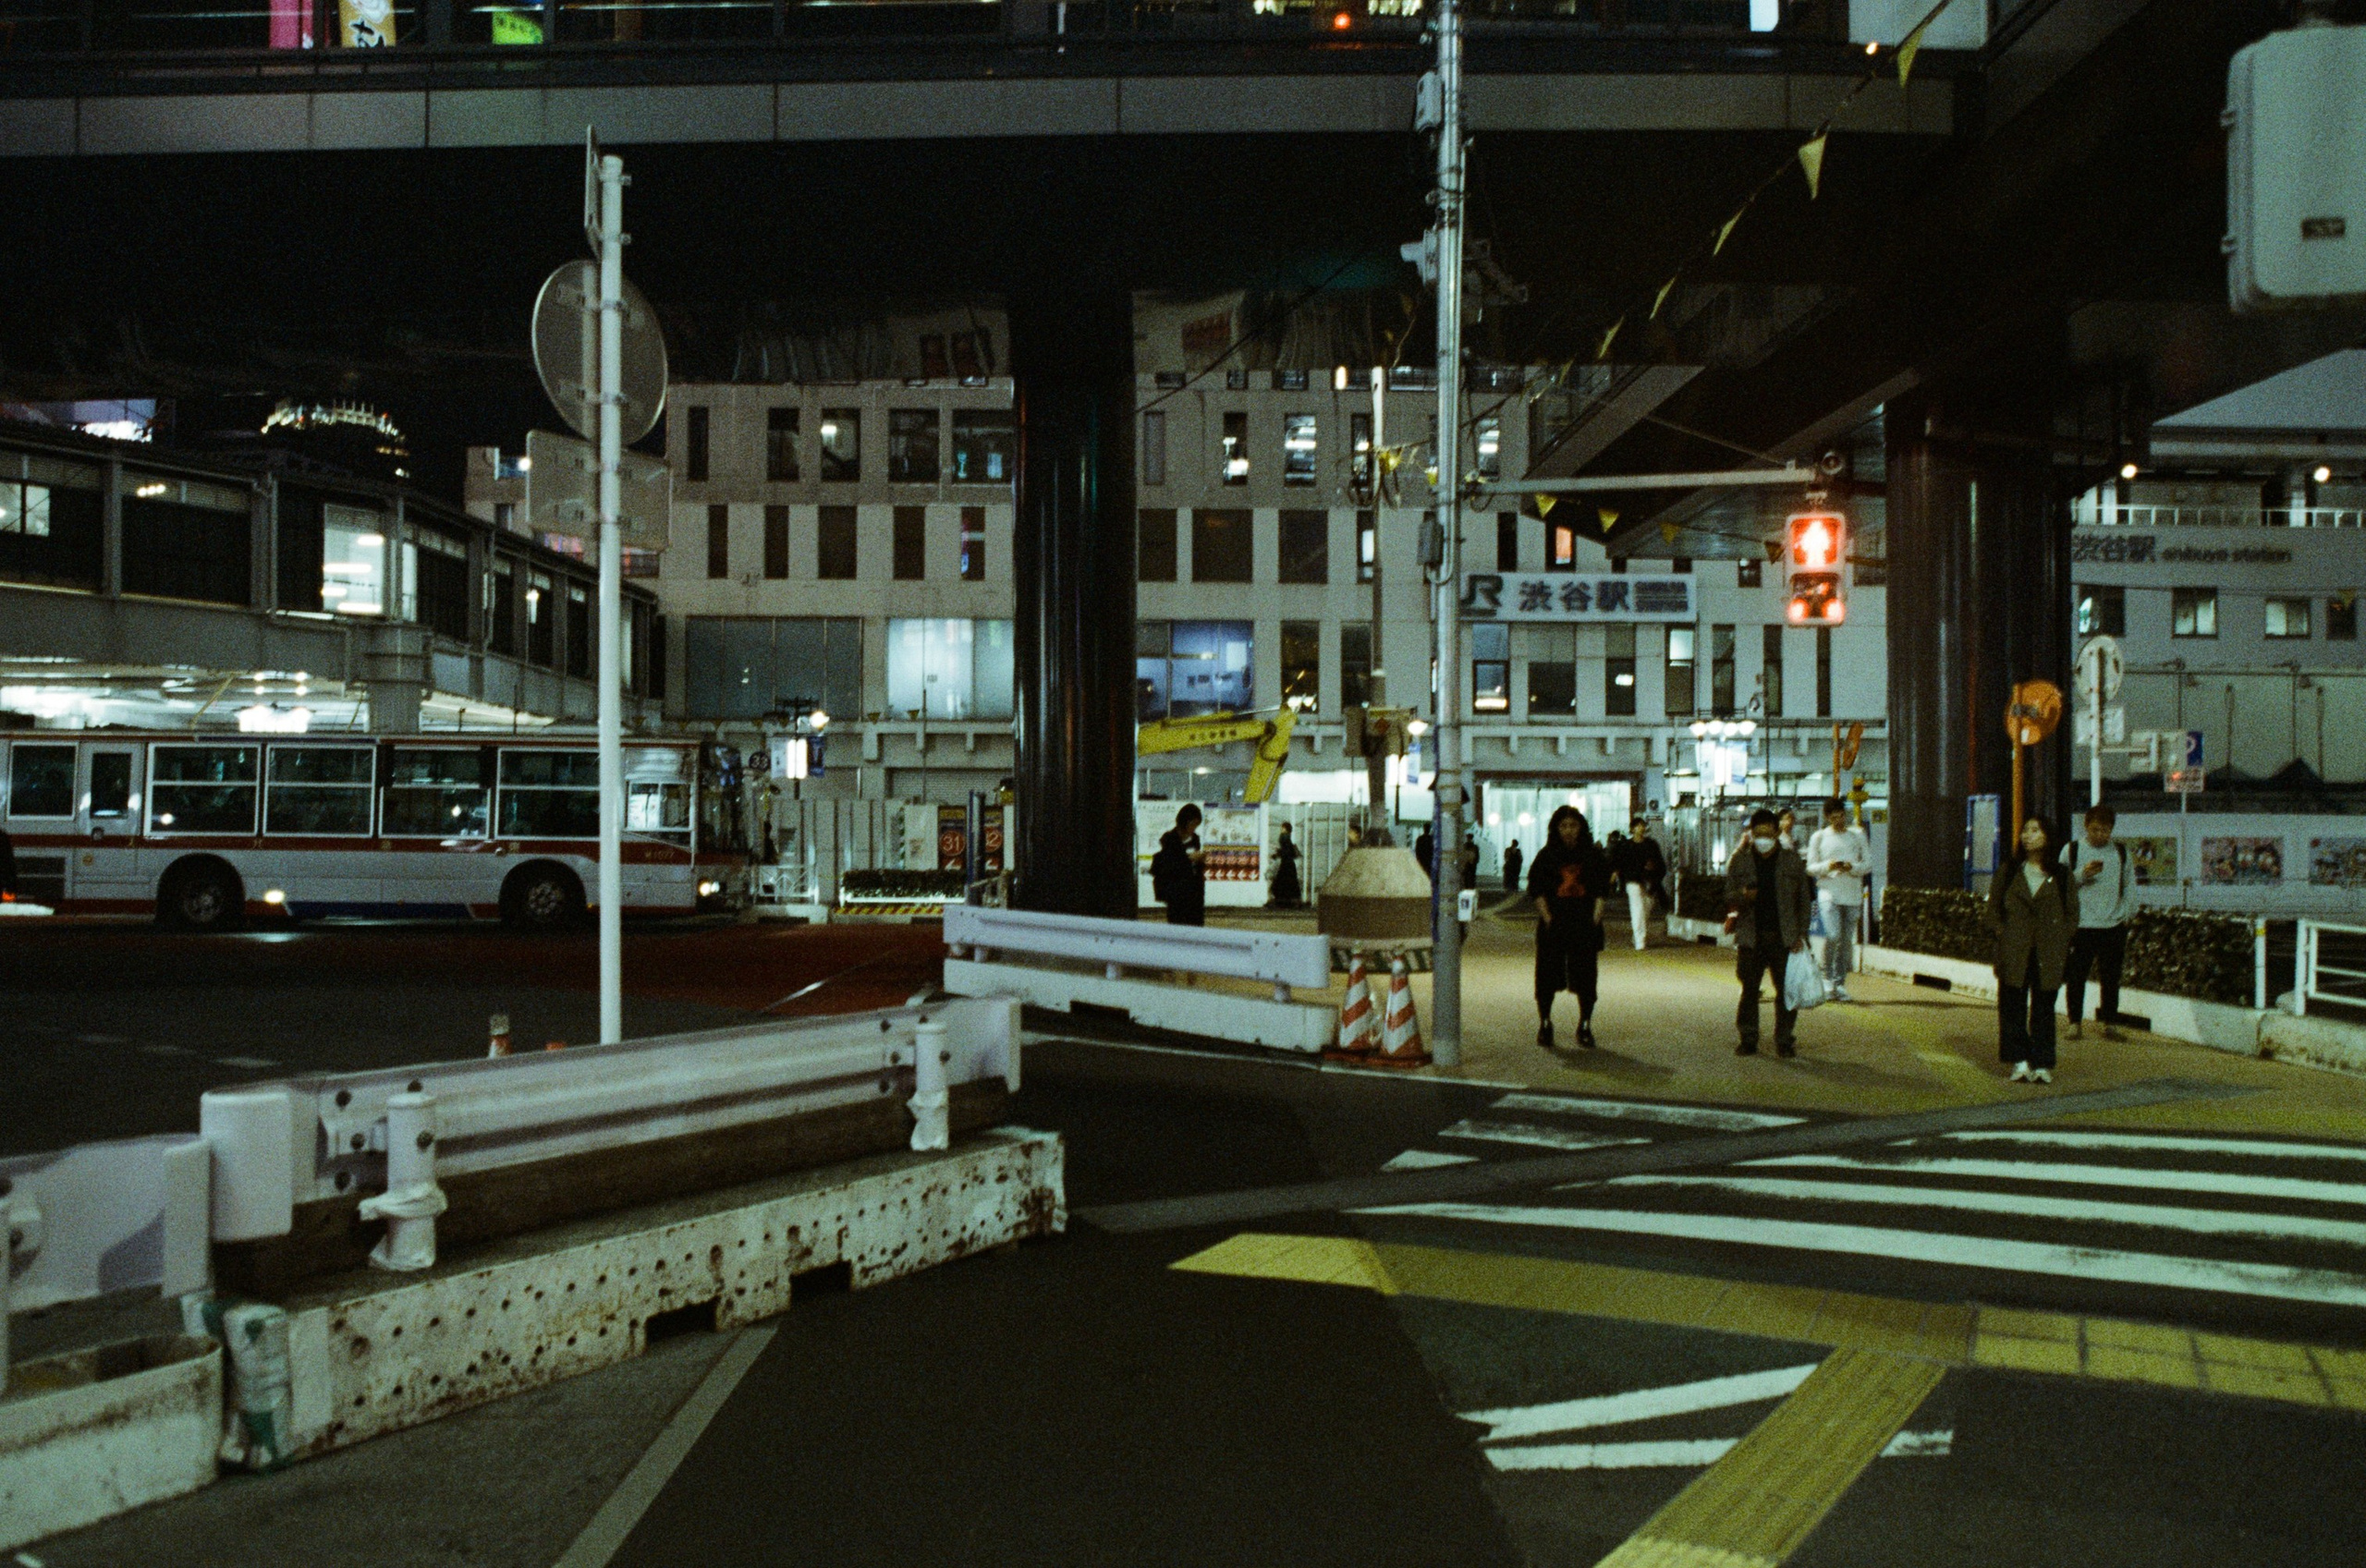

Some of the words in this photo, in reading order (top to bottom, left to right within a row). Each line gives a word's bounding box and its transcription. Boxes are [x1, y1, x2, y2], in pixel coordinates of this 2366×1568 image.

[1460, 575, 1503, 607] JR
[1518, 580, 1630, 612] 渋谷駅
[942, 834, 960, 851] 31
